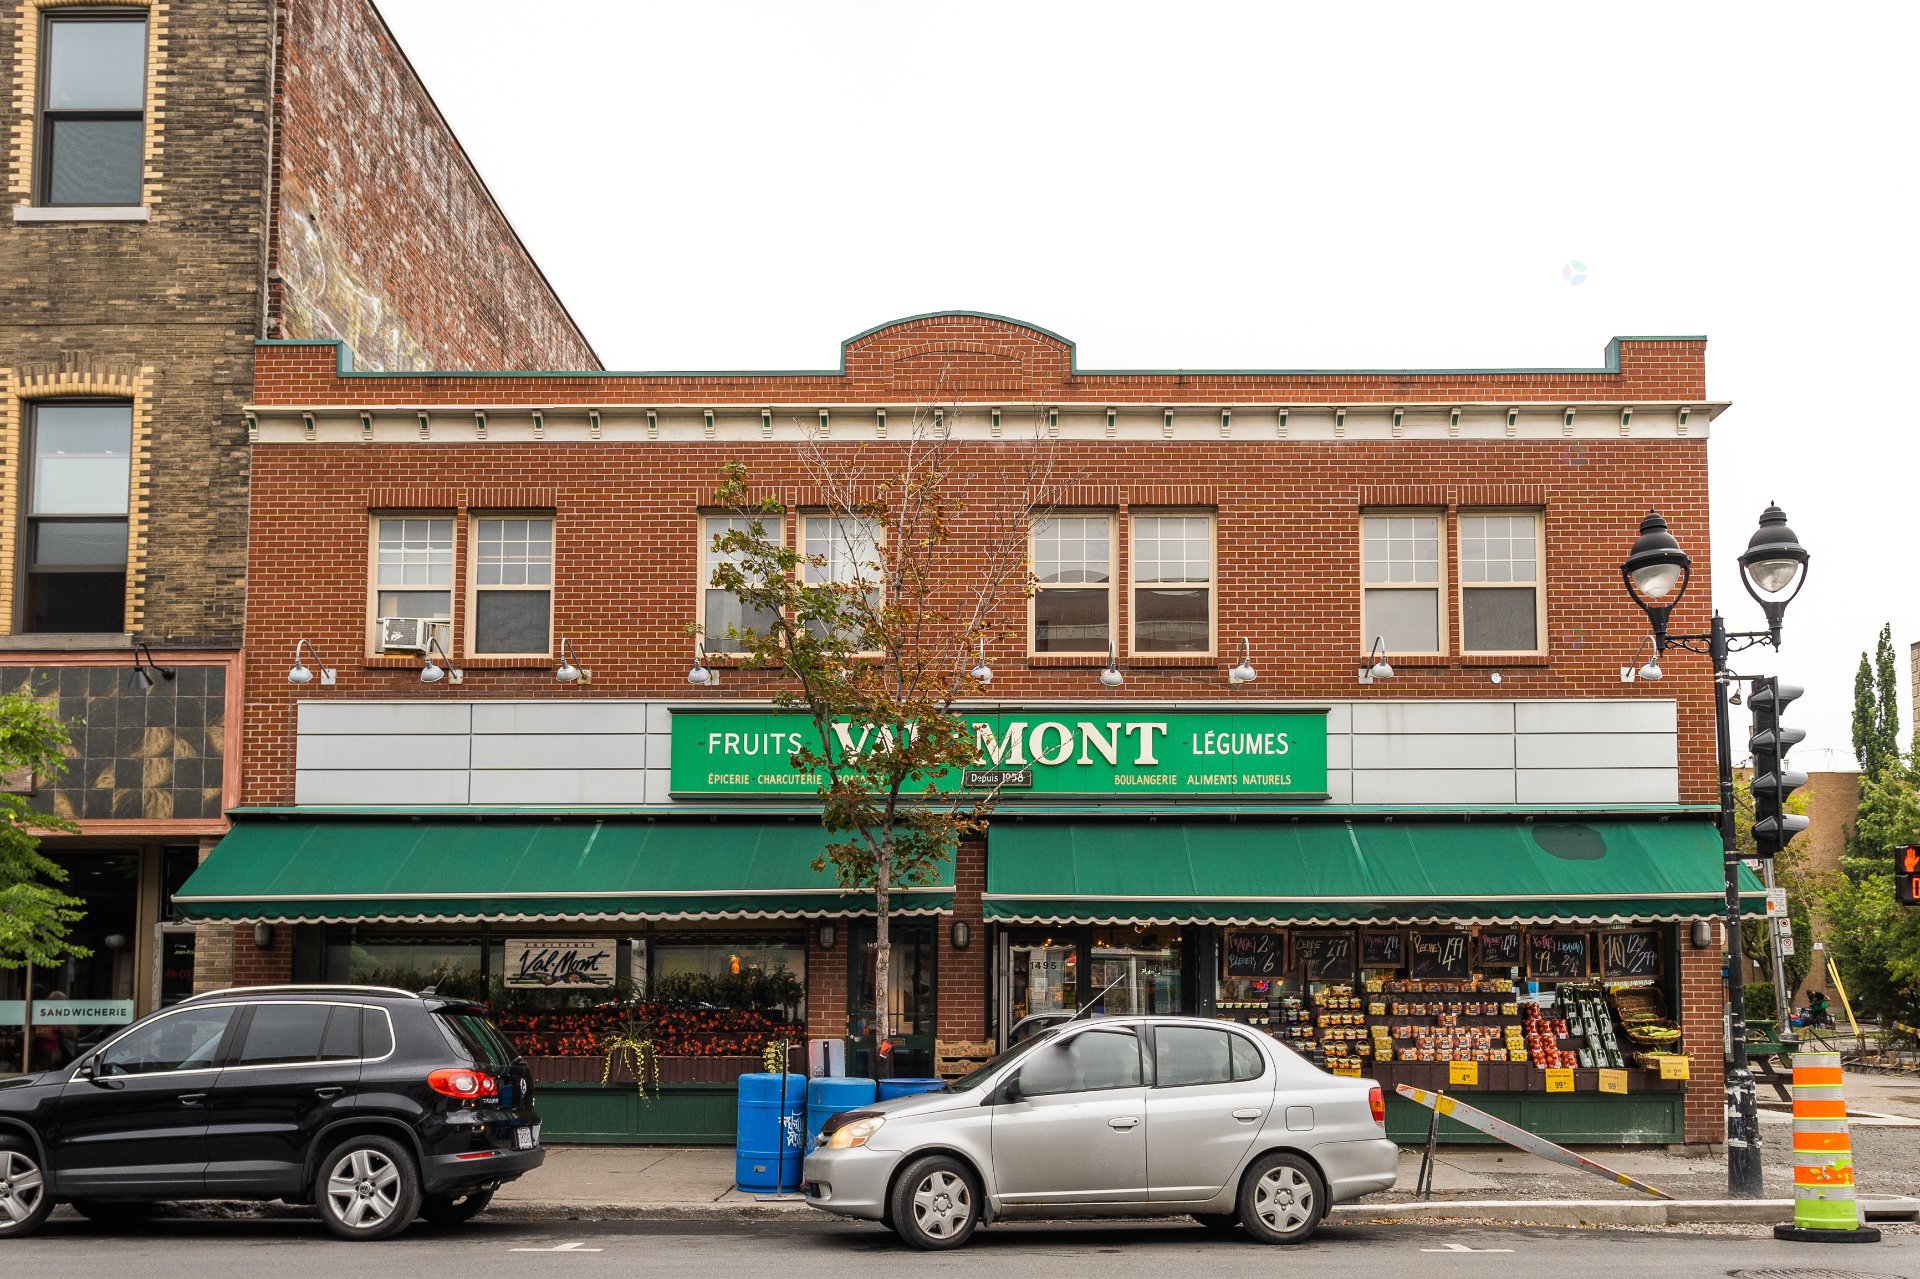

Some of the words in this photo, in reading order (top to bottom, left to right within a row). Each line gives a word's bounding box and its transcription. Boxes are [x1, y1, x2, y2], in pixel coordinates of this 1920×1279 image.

[709, 732, 802, 755] FRUITS
[1192, 730, 1289, 755] LÉGUMES
[708, 773, 750, 785] ÉPICERIE
[757, 774, 822, 785] CHARCUTERIE
[831, 774, 885, 785] ROMAS
[971, 773, 999, 784] Depuis
[1114, 774, 1177, 785] BOULANGERIE
[1187, 774, 1238, 785] ALIMENTS
[1242, 774, 1291, 785] NATURELS
[1030, 961, 1057, 970] 1495
[40, 1008, 127, 1017] SANDWICHERIE
